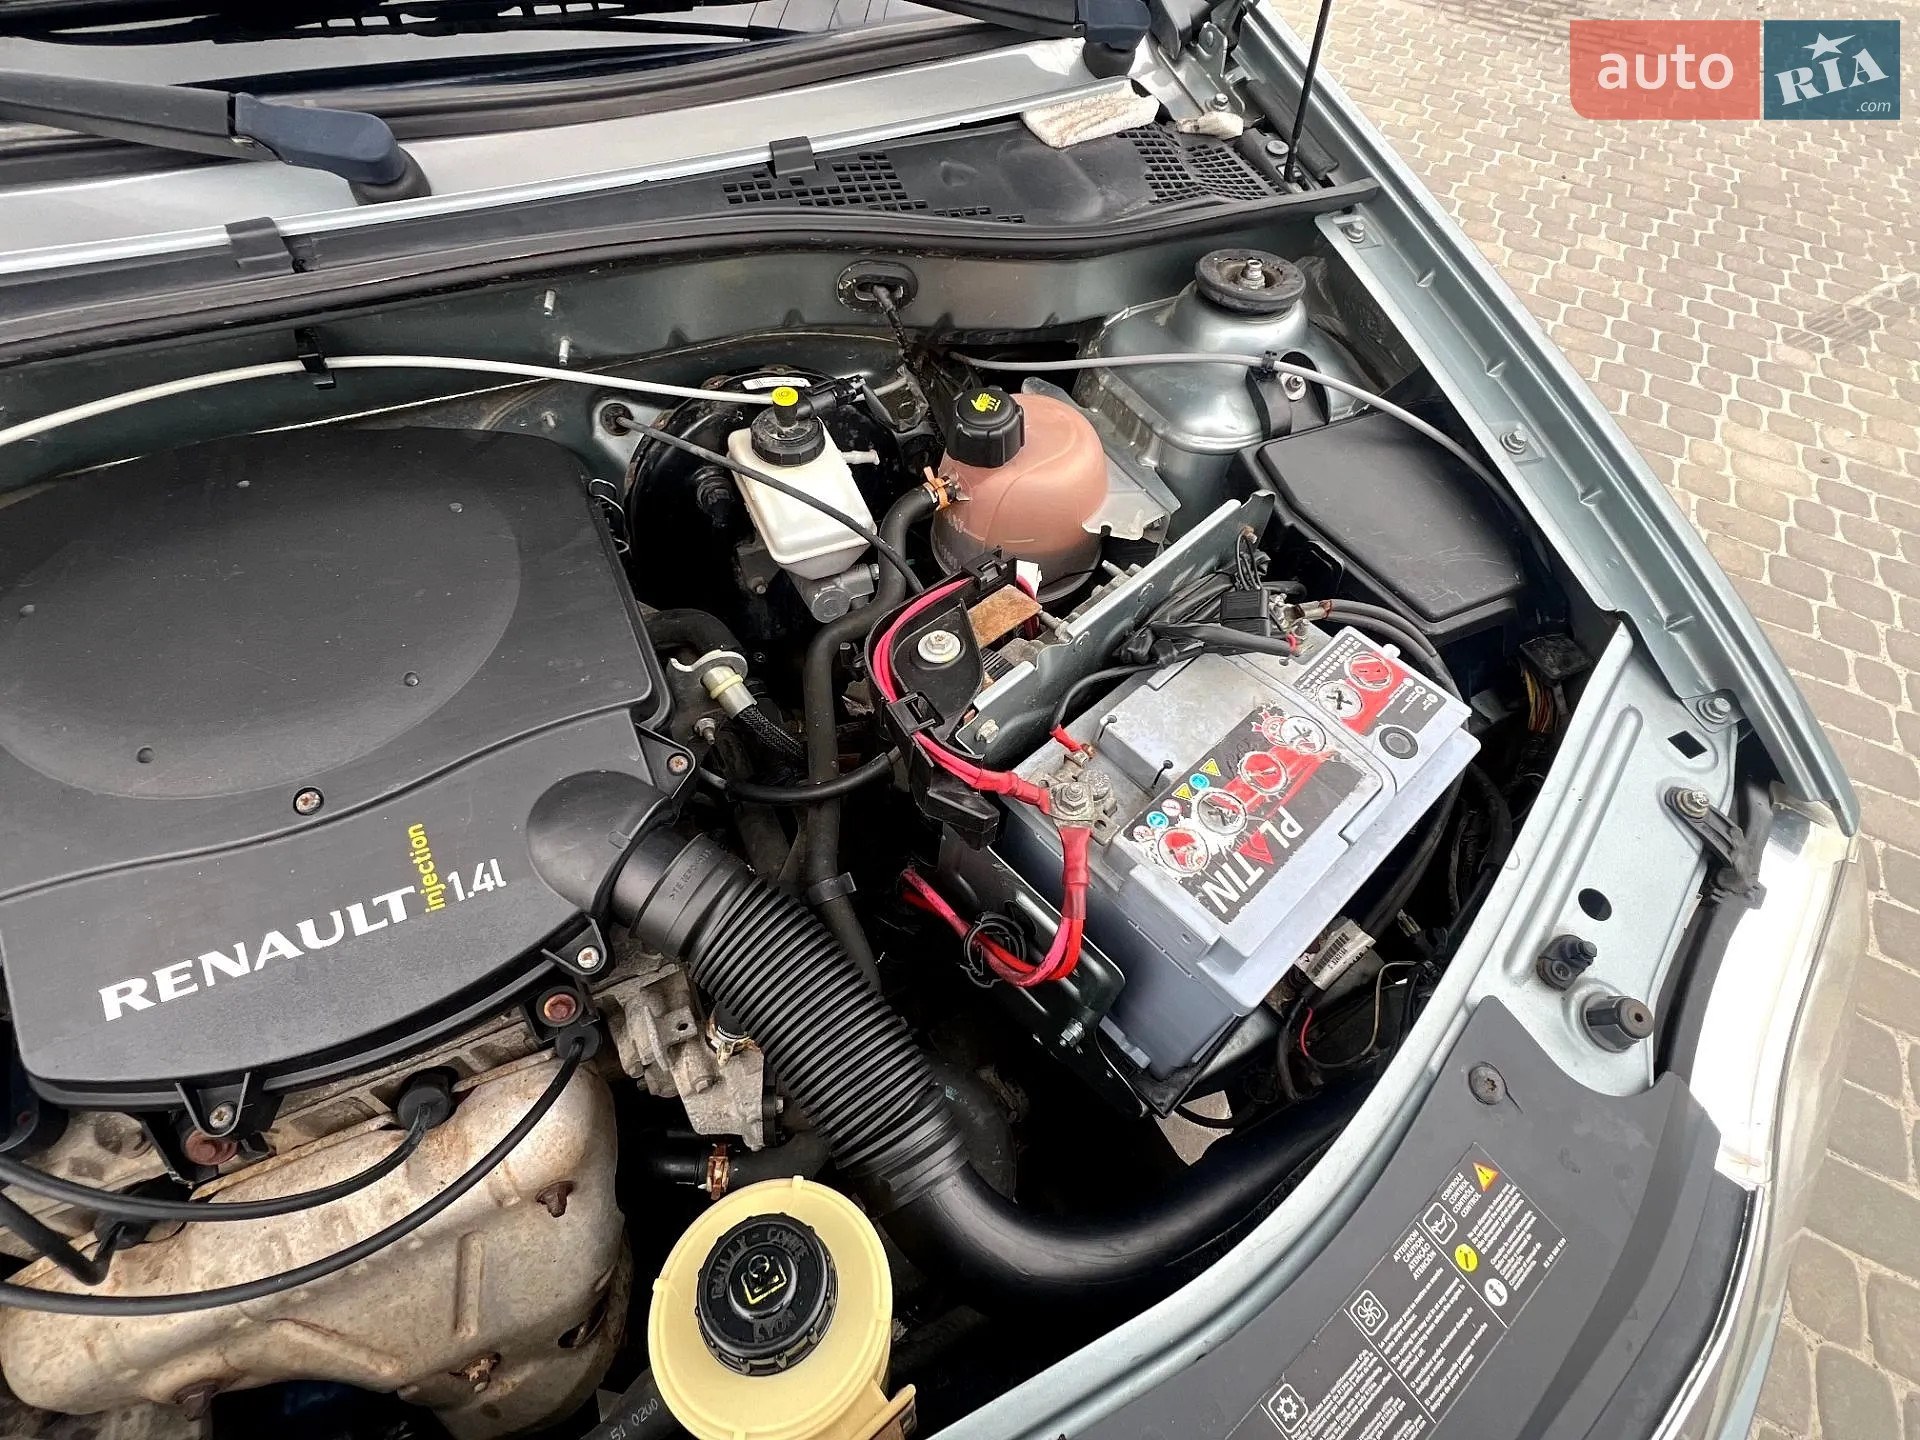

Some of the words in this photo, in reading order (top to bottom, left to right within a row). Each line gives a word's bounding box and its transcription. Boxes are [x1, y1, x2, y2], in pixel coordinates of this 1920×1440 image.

[408, 823, 446, 912] injection
[98, 886, 415, 1021] RENAULT
[1449, 1179, 1469, 1204] CONTROL
[1460, 1192, 1481, 1218] CONTROL
[1393, 1229, 1419, 1262] ATTENTION
[1403, 1236, 1424, 1263] CAUTION
[631, 1398, 659, 1427] 0200
